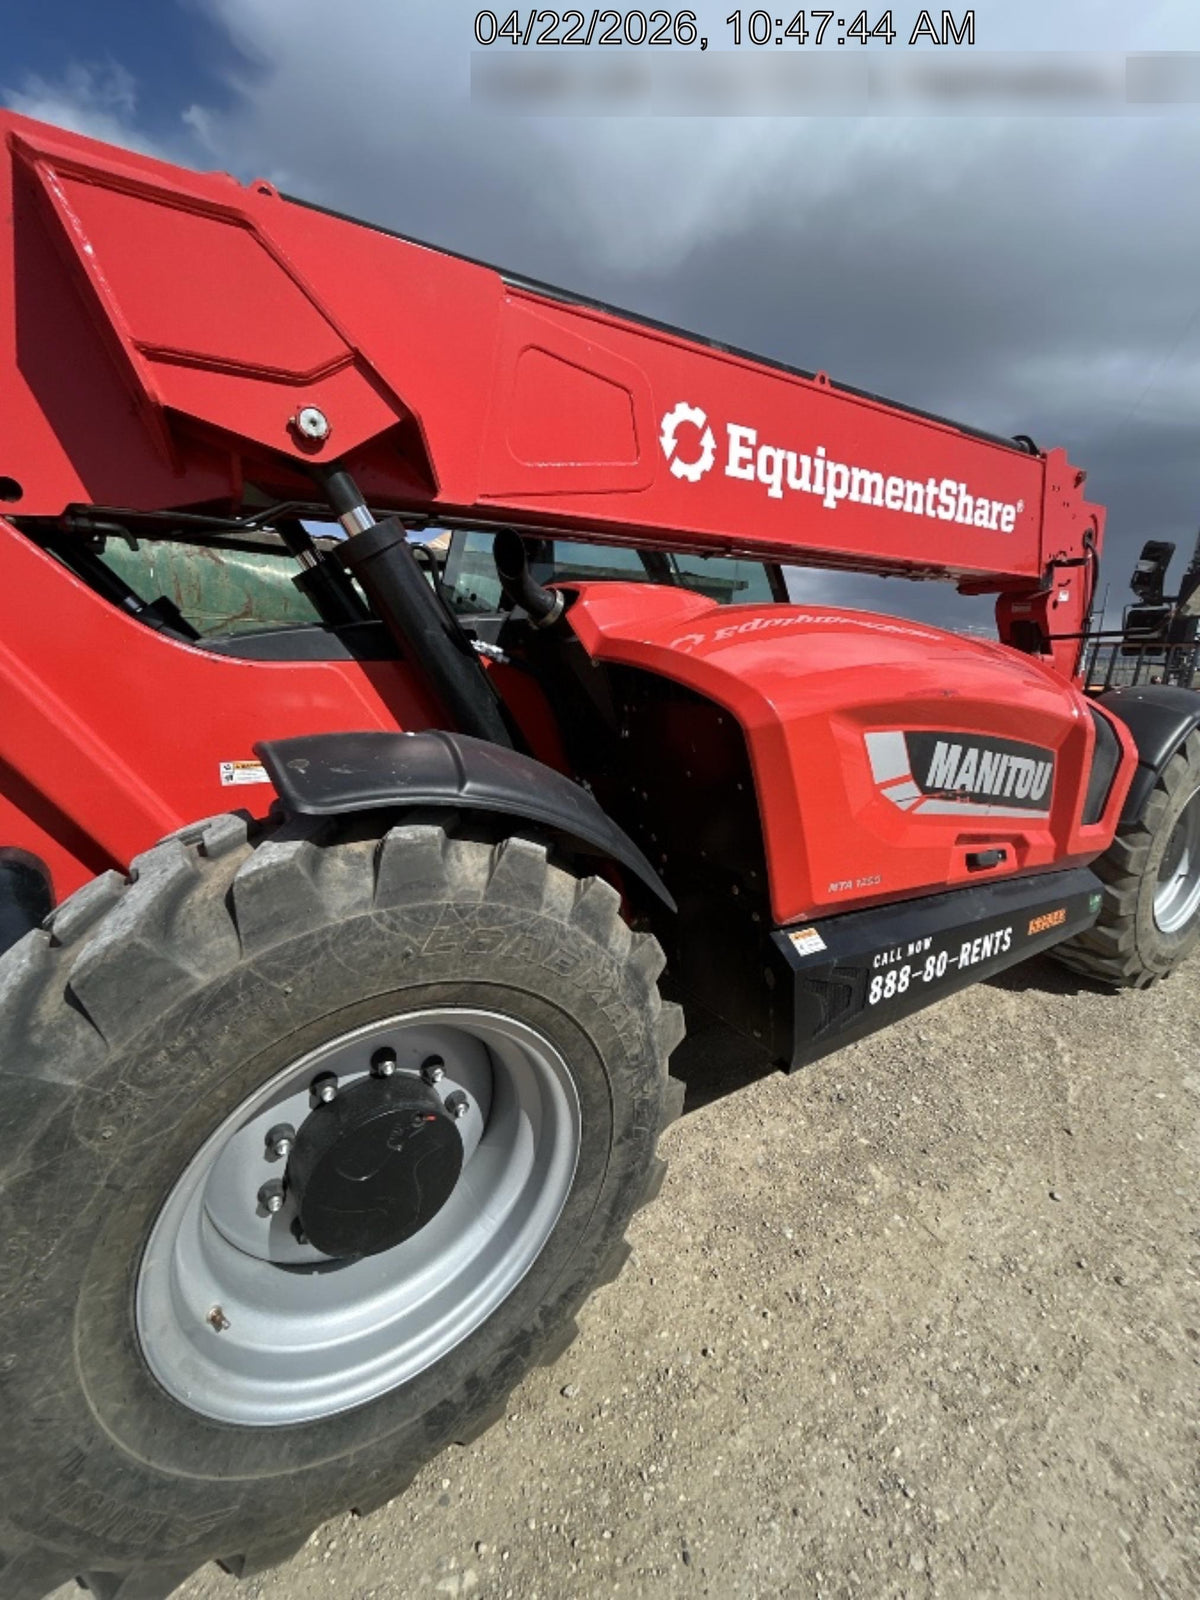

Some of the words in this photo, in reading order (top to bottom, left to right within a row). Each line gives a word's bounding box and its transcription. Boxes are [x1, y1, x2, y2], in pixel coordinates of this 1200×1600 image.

[925, 740, 1053, 801] MANITOU
[868, 926, 1013, 1006] 888-80-RENTS
[873, 947, 902, 968] CALL
[906, 936, 933, 957] NOW
